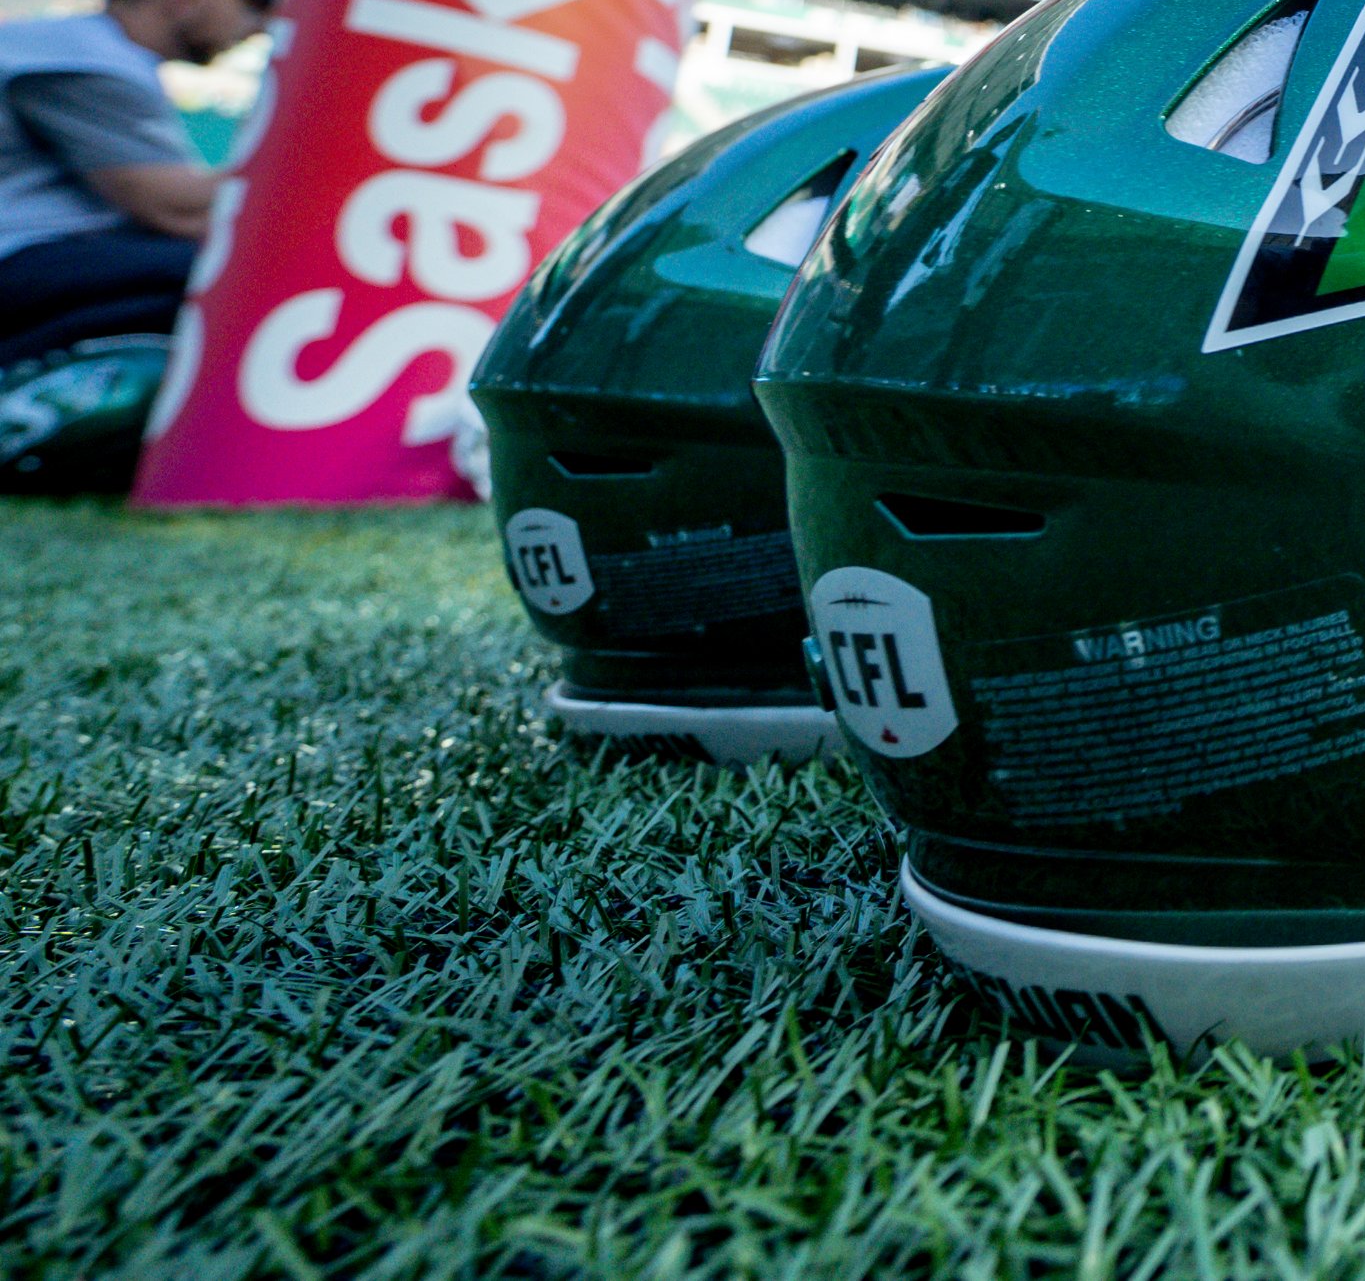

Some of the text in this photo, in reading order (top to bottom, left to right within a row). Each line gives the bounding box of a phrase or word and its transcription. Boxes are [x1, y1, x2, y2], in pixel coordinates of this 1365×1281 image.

[517, 542, 576, 586] CFL
[1074, 615, 1221, 663] WARNING
[827, 631, 928, 709] CFL
